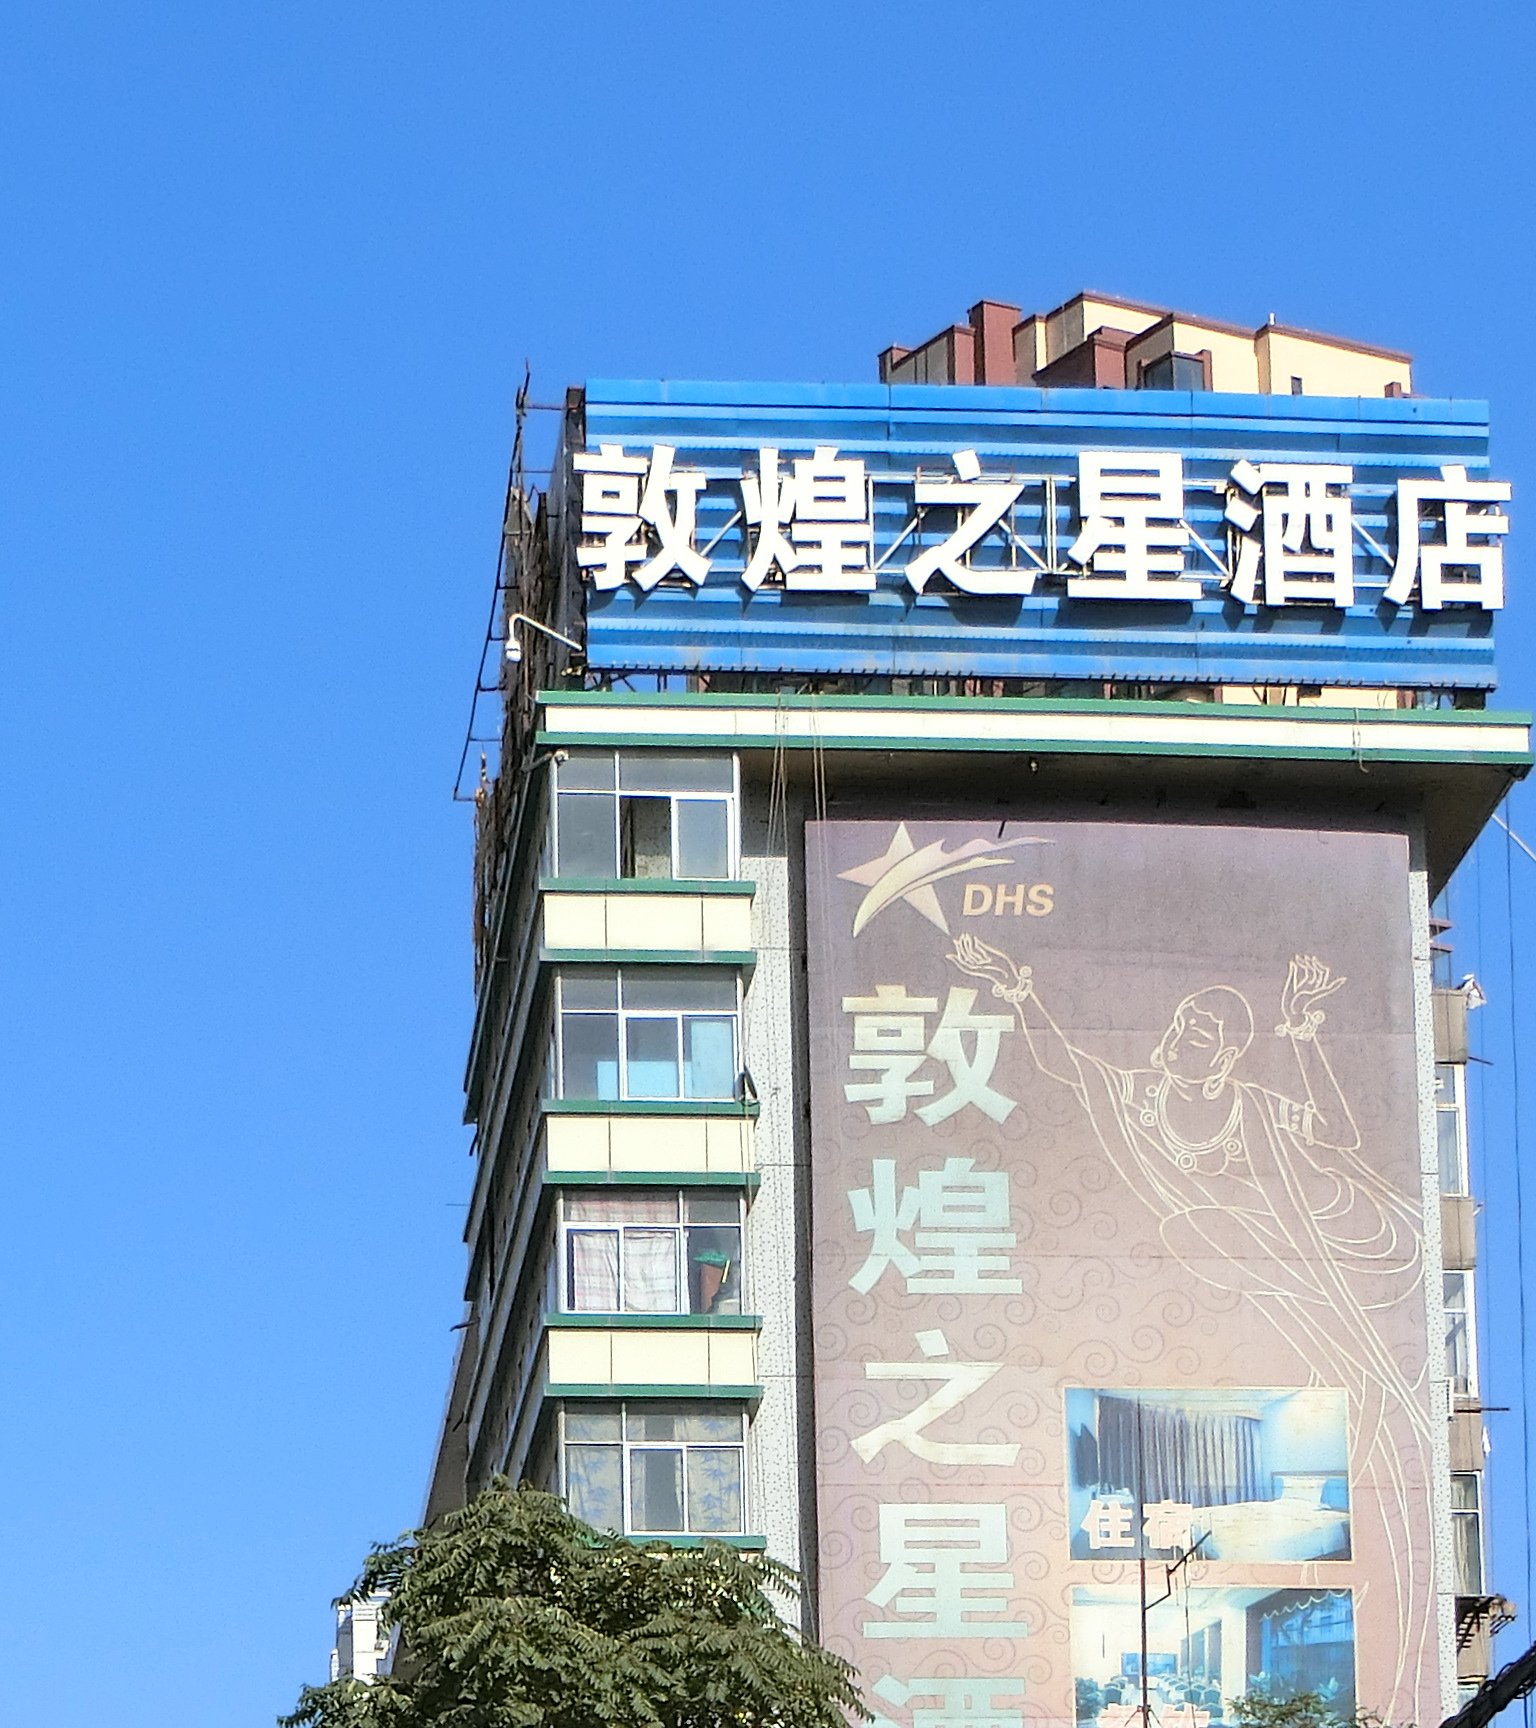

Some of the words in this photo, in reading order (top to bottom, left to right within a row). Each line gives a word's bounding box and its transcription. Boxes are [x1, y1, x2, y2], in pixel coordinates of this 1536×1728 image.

[574, 443, 1514, 613] 敦煌之星酒店
[962, 883, 1056, 918] DHS
[1080, 1499, 1194, 1551] 住宿
